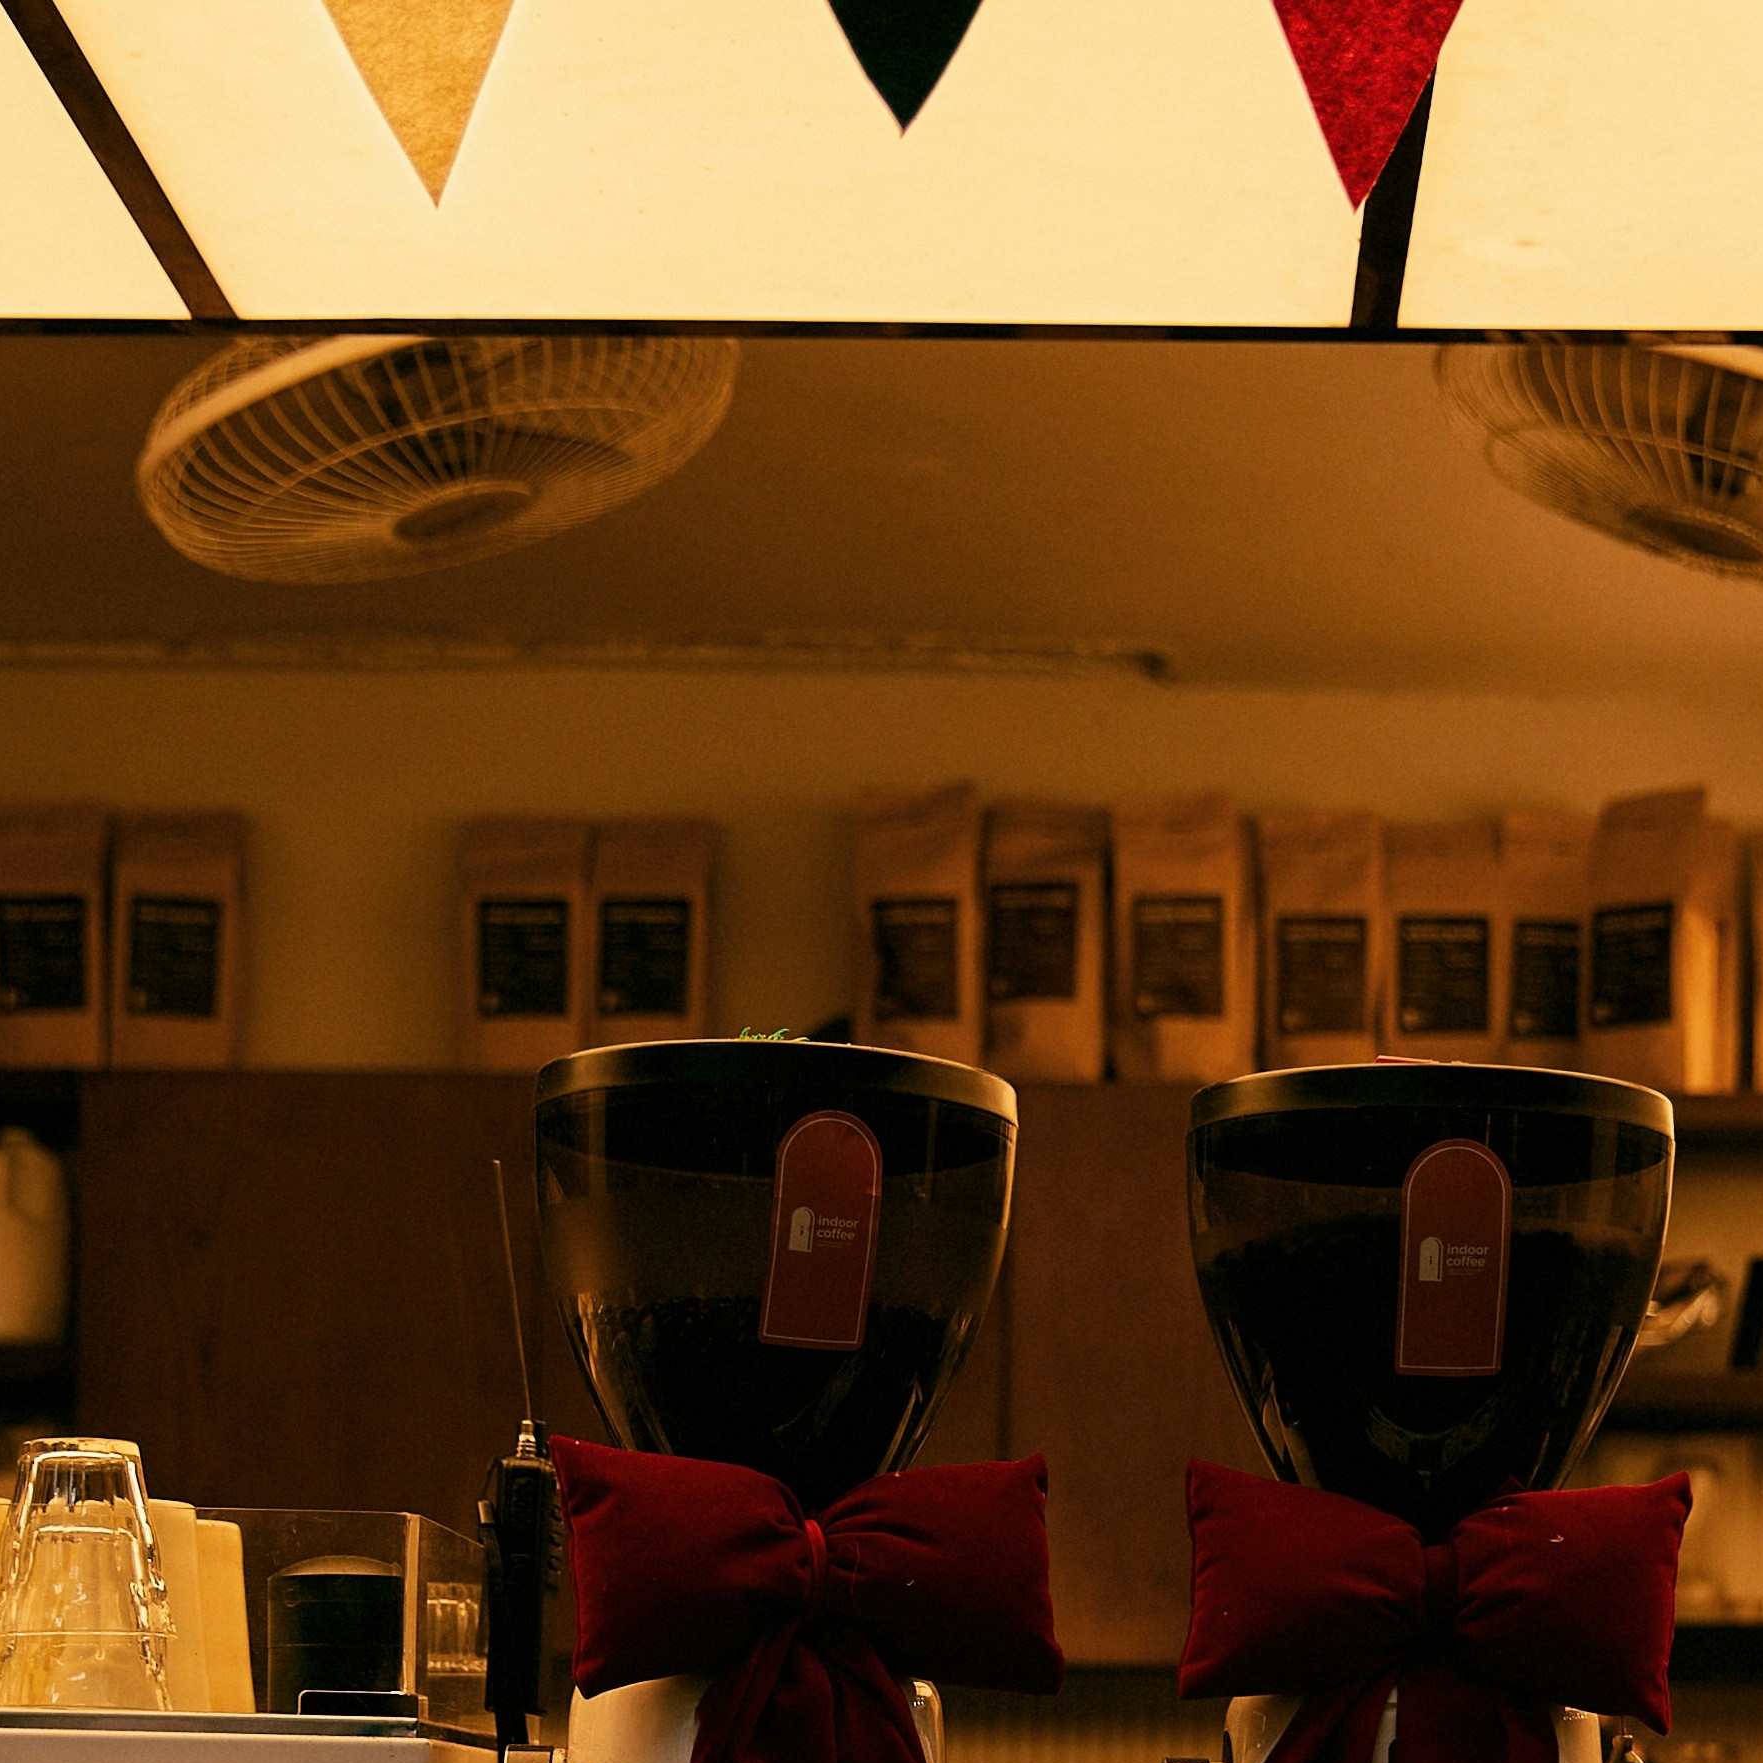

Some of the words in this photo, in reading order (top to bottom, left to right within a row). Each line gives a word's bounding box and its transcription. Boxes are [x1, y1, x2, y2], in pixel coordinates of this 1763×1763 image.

[818, 1215, 859, 1229] indoor
[817, 1229, 855, 1240] coffee
[1447, 1243, 1489, 1255] indoor
[1446, 1256, 1485, 1266] coffee
